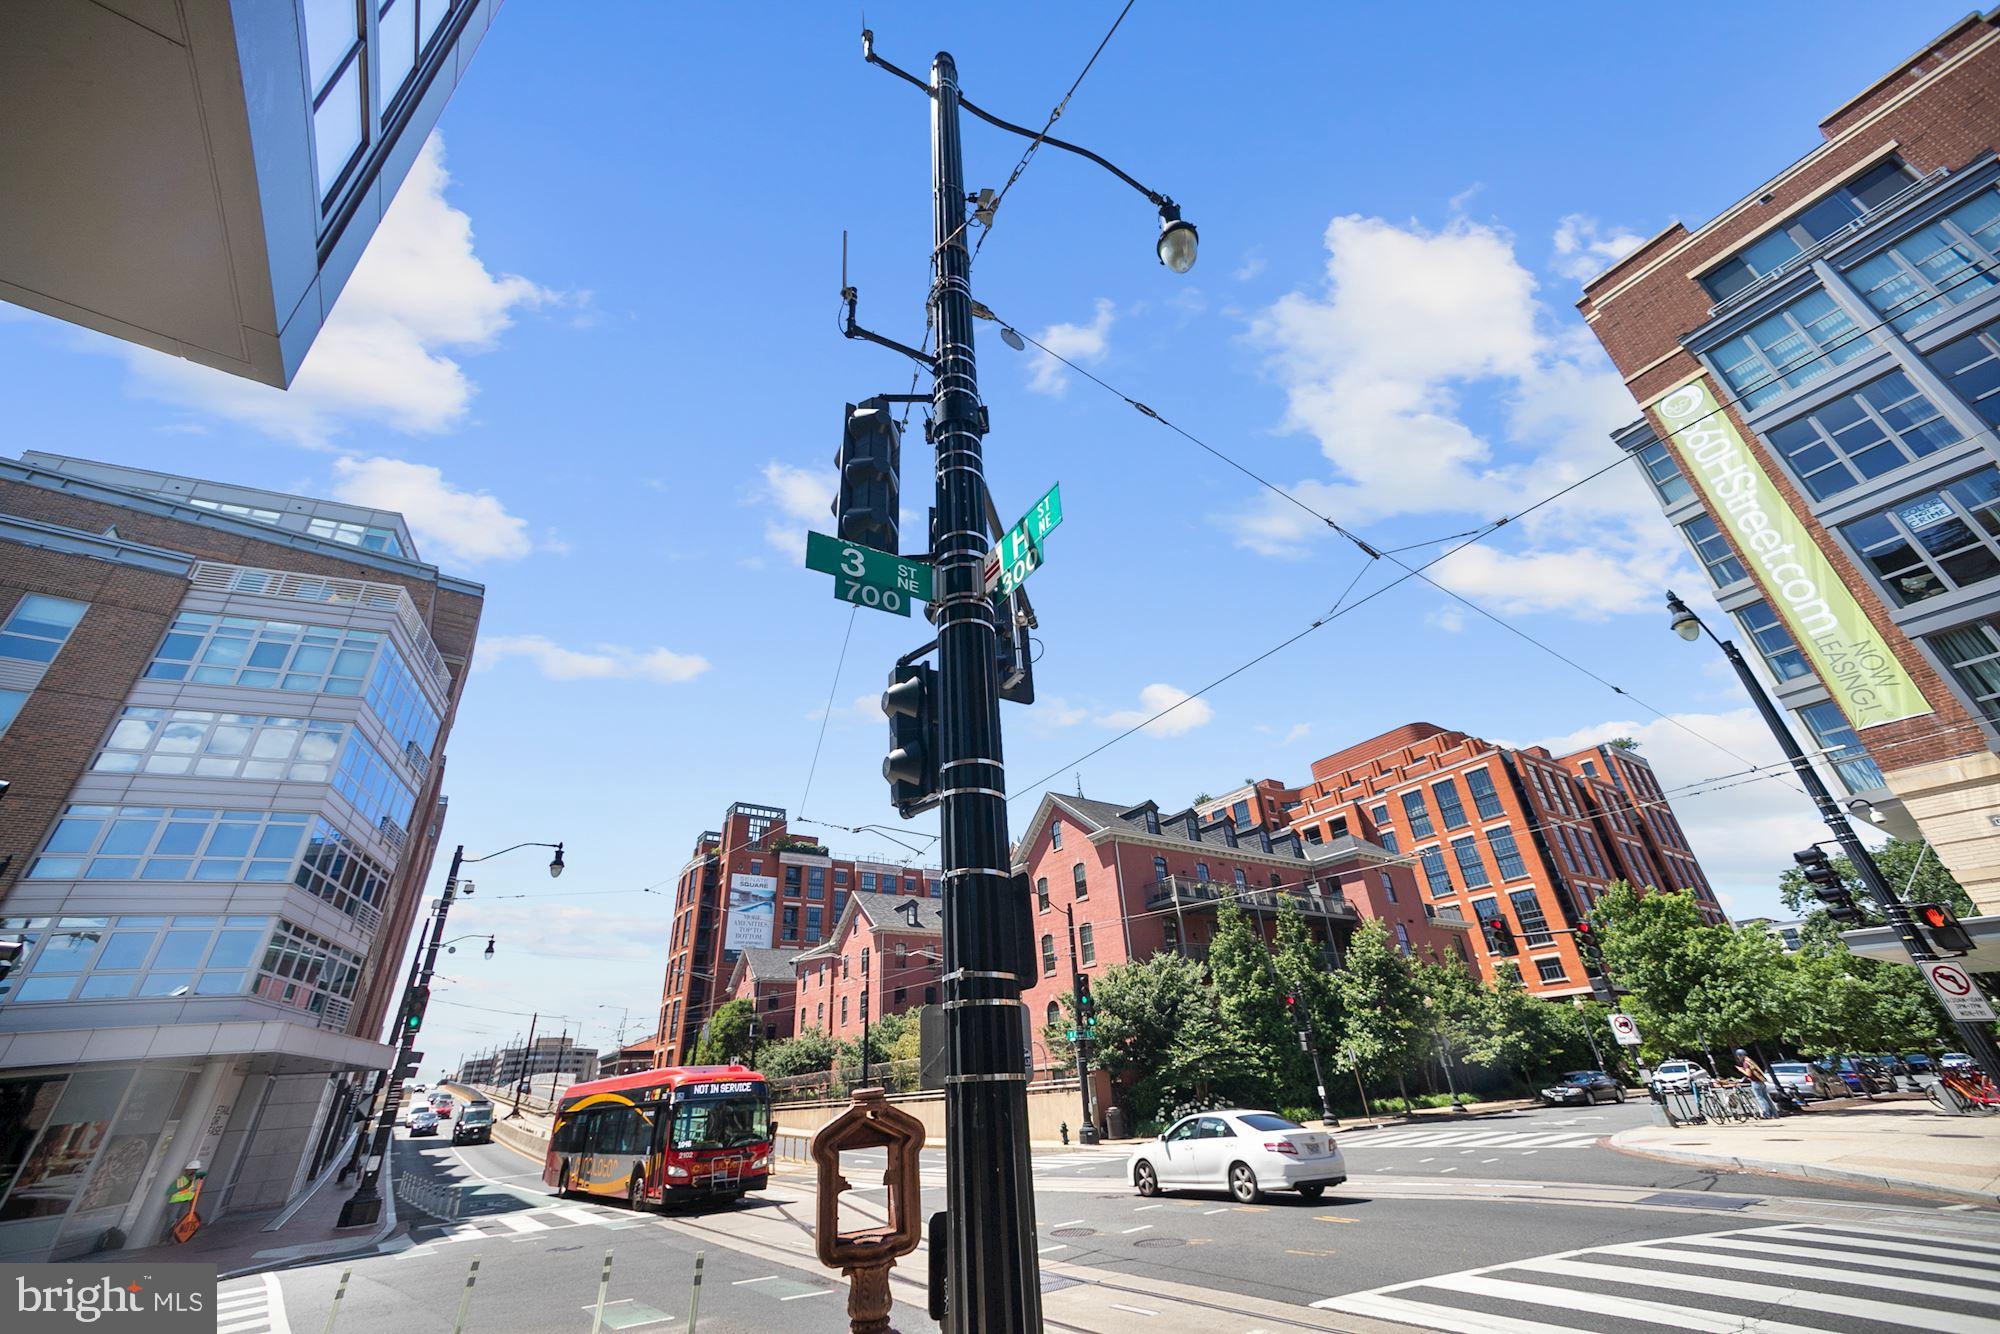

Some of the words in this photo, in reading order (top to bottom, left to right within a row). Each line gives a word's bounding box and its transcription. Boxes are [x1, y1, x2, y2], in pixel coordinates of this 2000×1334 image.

[1012, 518, 1030, 560] H
[1037, 497, 1051, 517] ST
[1038, 515, 1052, 536] NE
[1677, 410, 1839, 636] 360HStreet.com
[1910, 508, 1949, 527] CRIME
[840, 548, 866, 578] 3
[897, 564, 918, 580] ST
[1001, 547, 1038, 595] 300
[844, 580, 901, 611] 700
[897, 577, 920, 593] NE
[1814, 633, 1882, 712] LEASING!
[1849, 640, 1900, 687] NOW
[740, 881, 768, 889] SQUARE
[694, 1084, 710, 1094] NOT
[710, 1083, 719, 1094] IN
[720, 1082, 752, 1093] SERVICE
[678, 1151, 694, 1159] 2102
